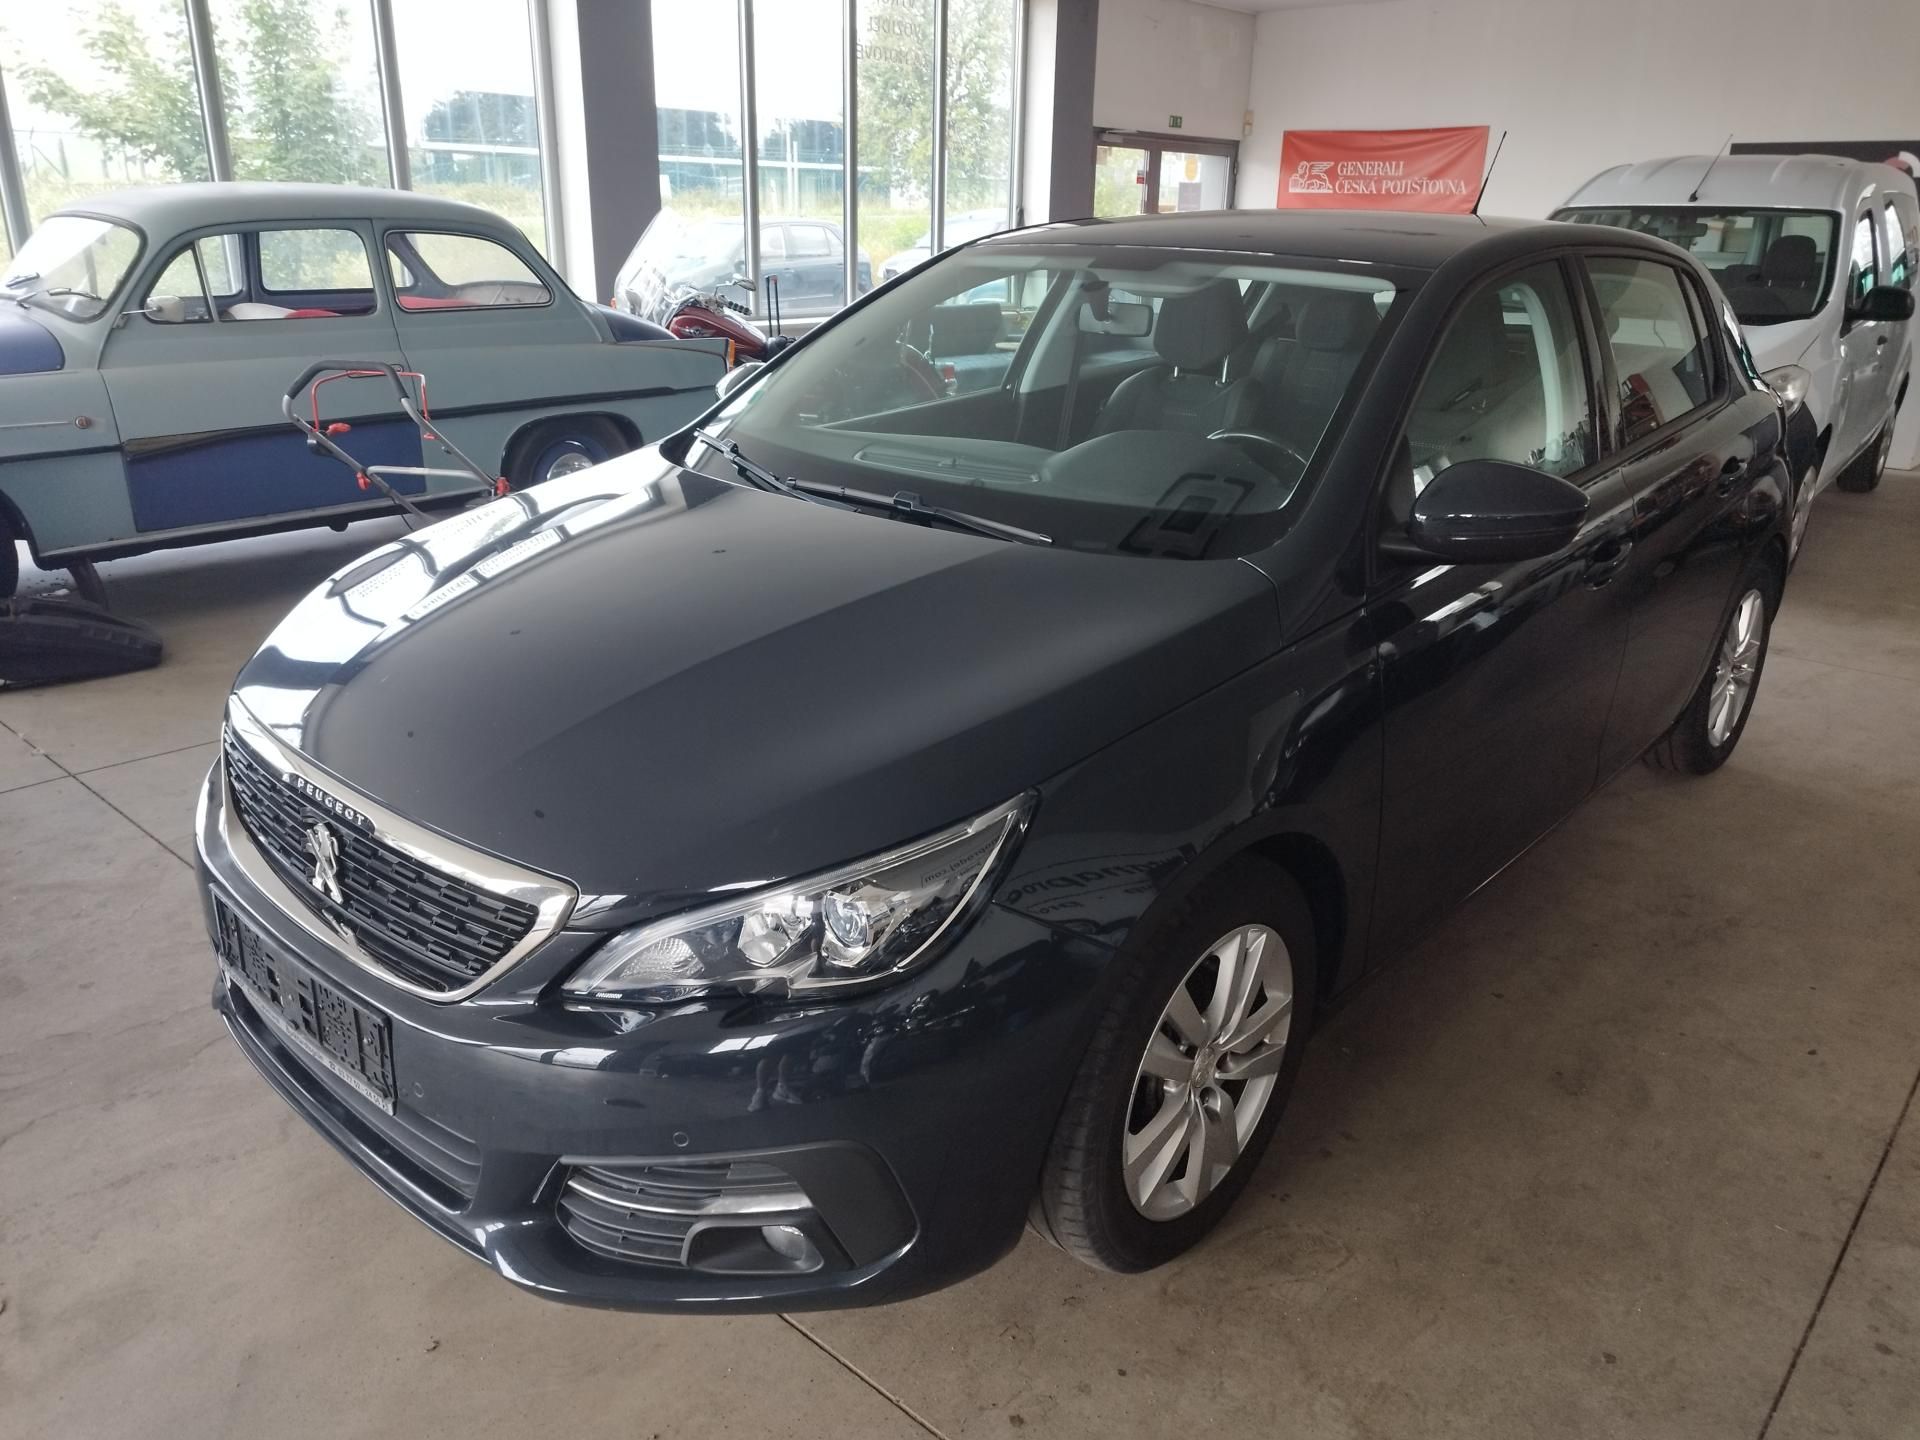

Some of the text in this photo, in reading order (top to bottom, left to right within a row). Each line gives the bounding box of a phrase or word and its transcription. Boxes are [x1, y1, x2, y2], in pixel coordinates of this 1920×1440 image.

[1337, 161, 1404, 176] GENERALI
[1335, 176, 1467, 195] ČESKÁ POJIŠŤOVNA
[297, 778, 365, 826] PEUGEOT
